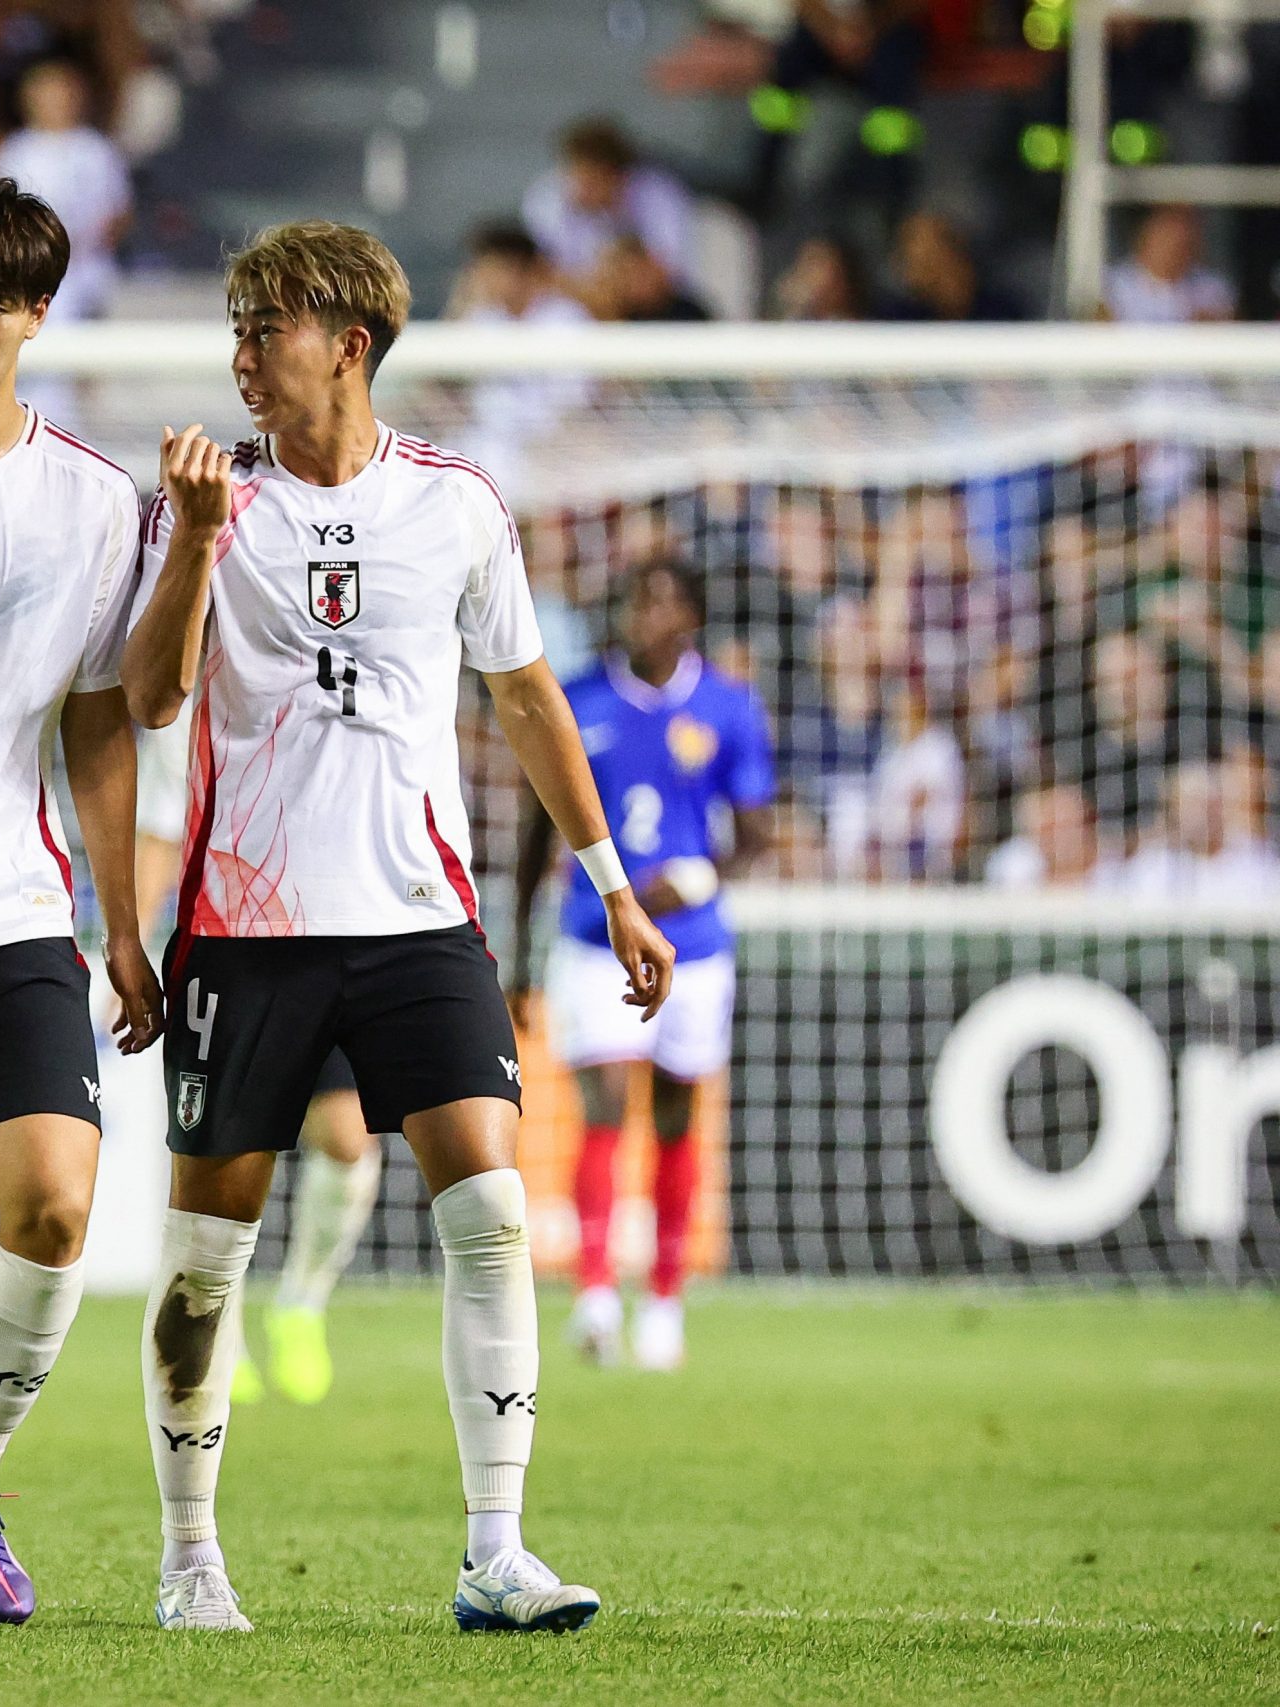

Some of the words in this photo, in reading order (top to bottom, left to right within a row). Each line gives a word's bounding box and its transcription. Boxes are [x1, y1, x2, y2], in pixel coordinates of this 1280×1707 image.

[311, 524, 355, 546] Y-3
[317, 646, 358, 717] 4
[187, 977, 219, 1061] 4
[160, 1424, 223, 1452] Y-3
